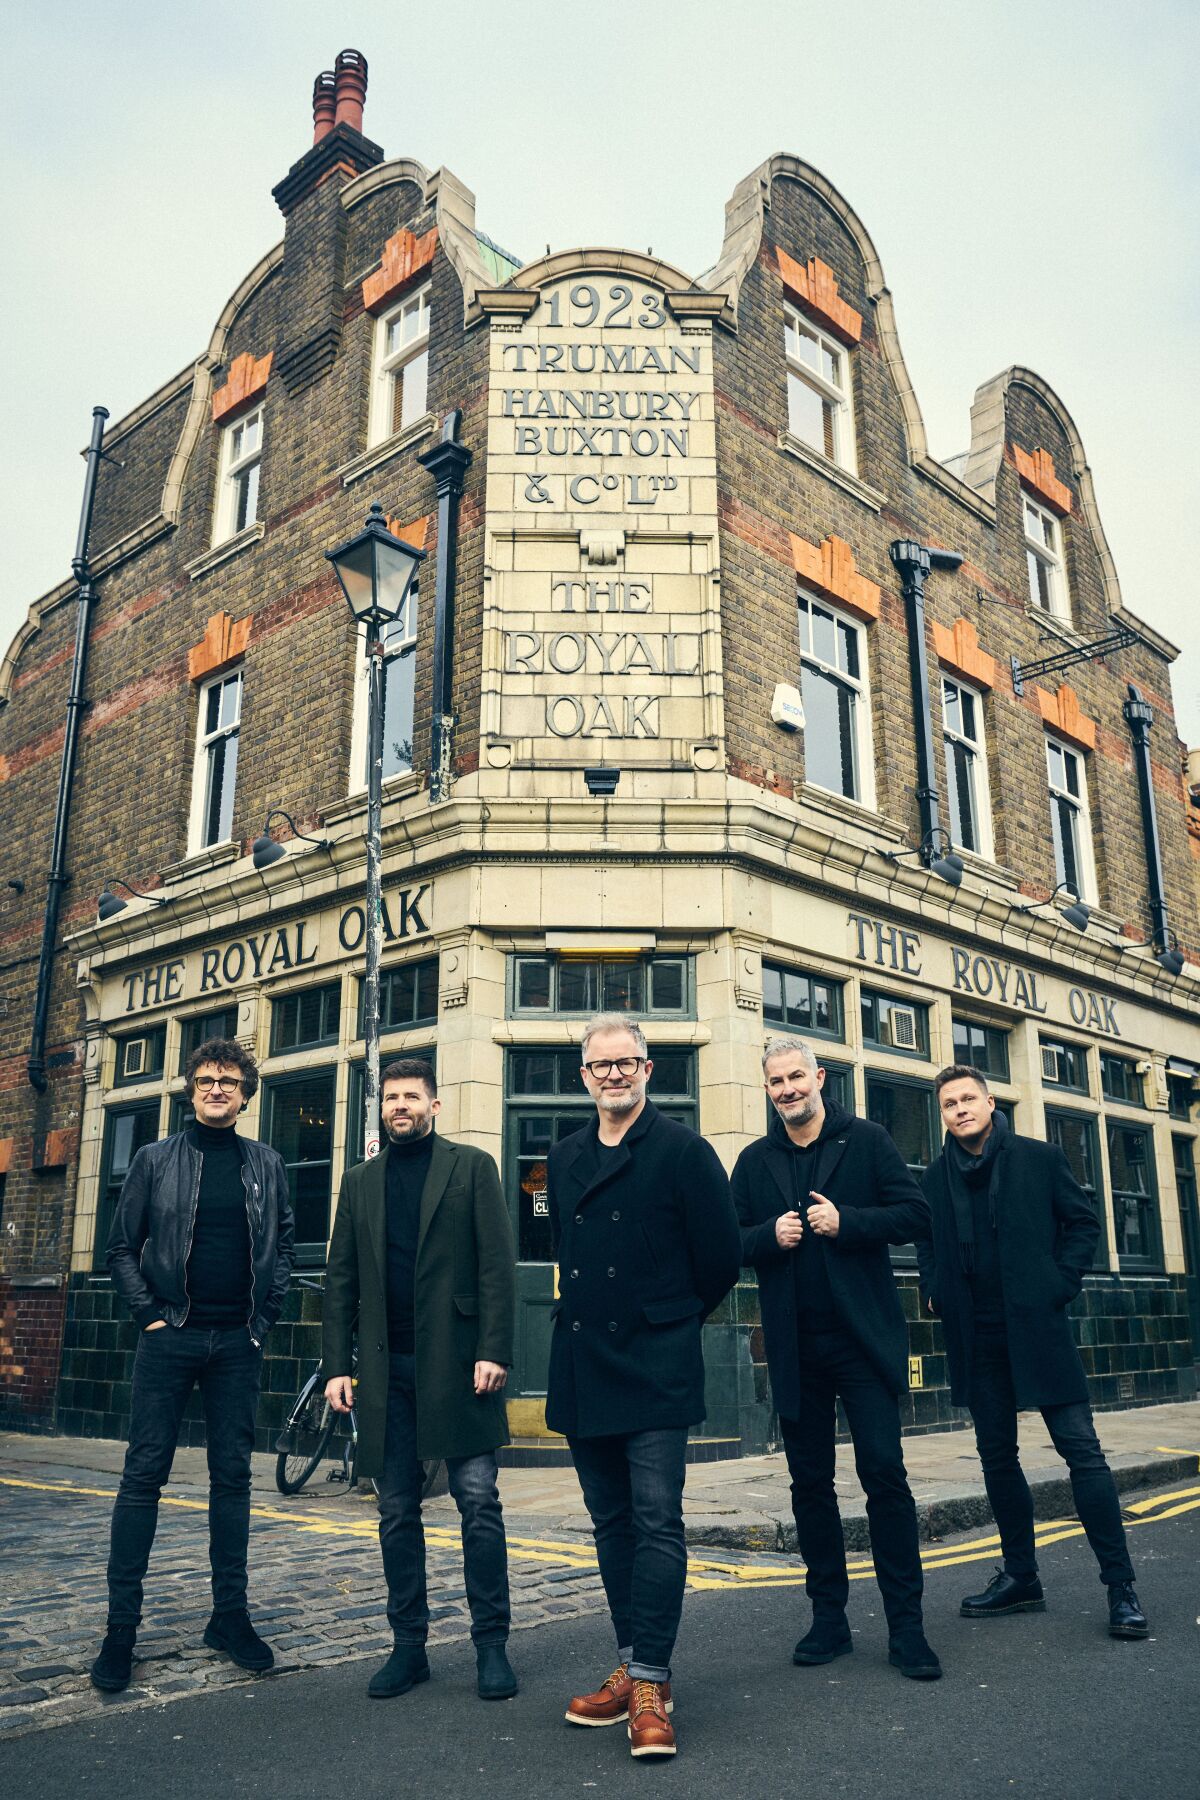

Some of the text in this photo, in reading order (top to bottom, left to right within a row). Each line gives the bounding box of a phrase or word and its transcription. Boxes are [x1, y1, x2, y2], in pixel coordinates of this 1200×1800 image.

[544, 284, 666, 329] 1923
[503, 345, 700, 373] TRUMAN
[503, 390, 699, 420] HANBURY
[515, 427, 688, 457] BUXTON
[524, 473, 554, 503] &
[552, 580, 651, 613] THE
[505, 633, 699, 675] ROYAL
[546, 696, 659, 738] OAK
[123, 959, 185, 1011] THE
[200, 922, 318, 991] ROYAL
[847, 913, 1121, 1036] THE ROYAL OAK
[910, 1360, 921, 1384] H
